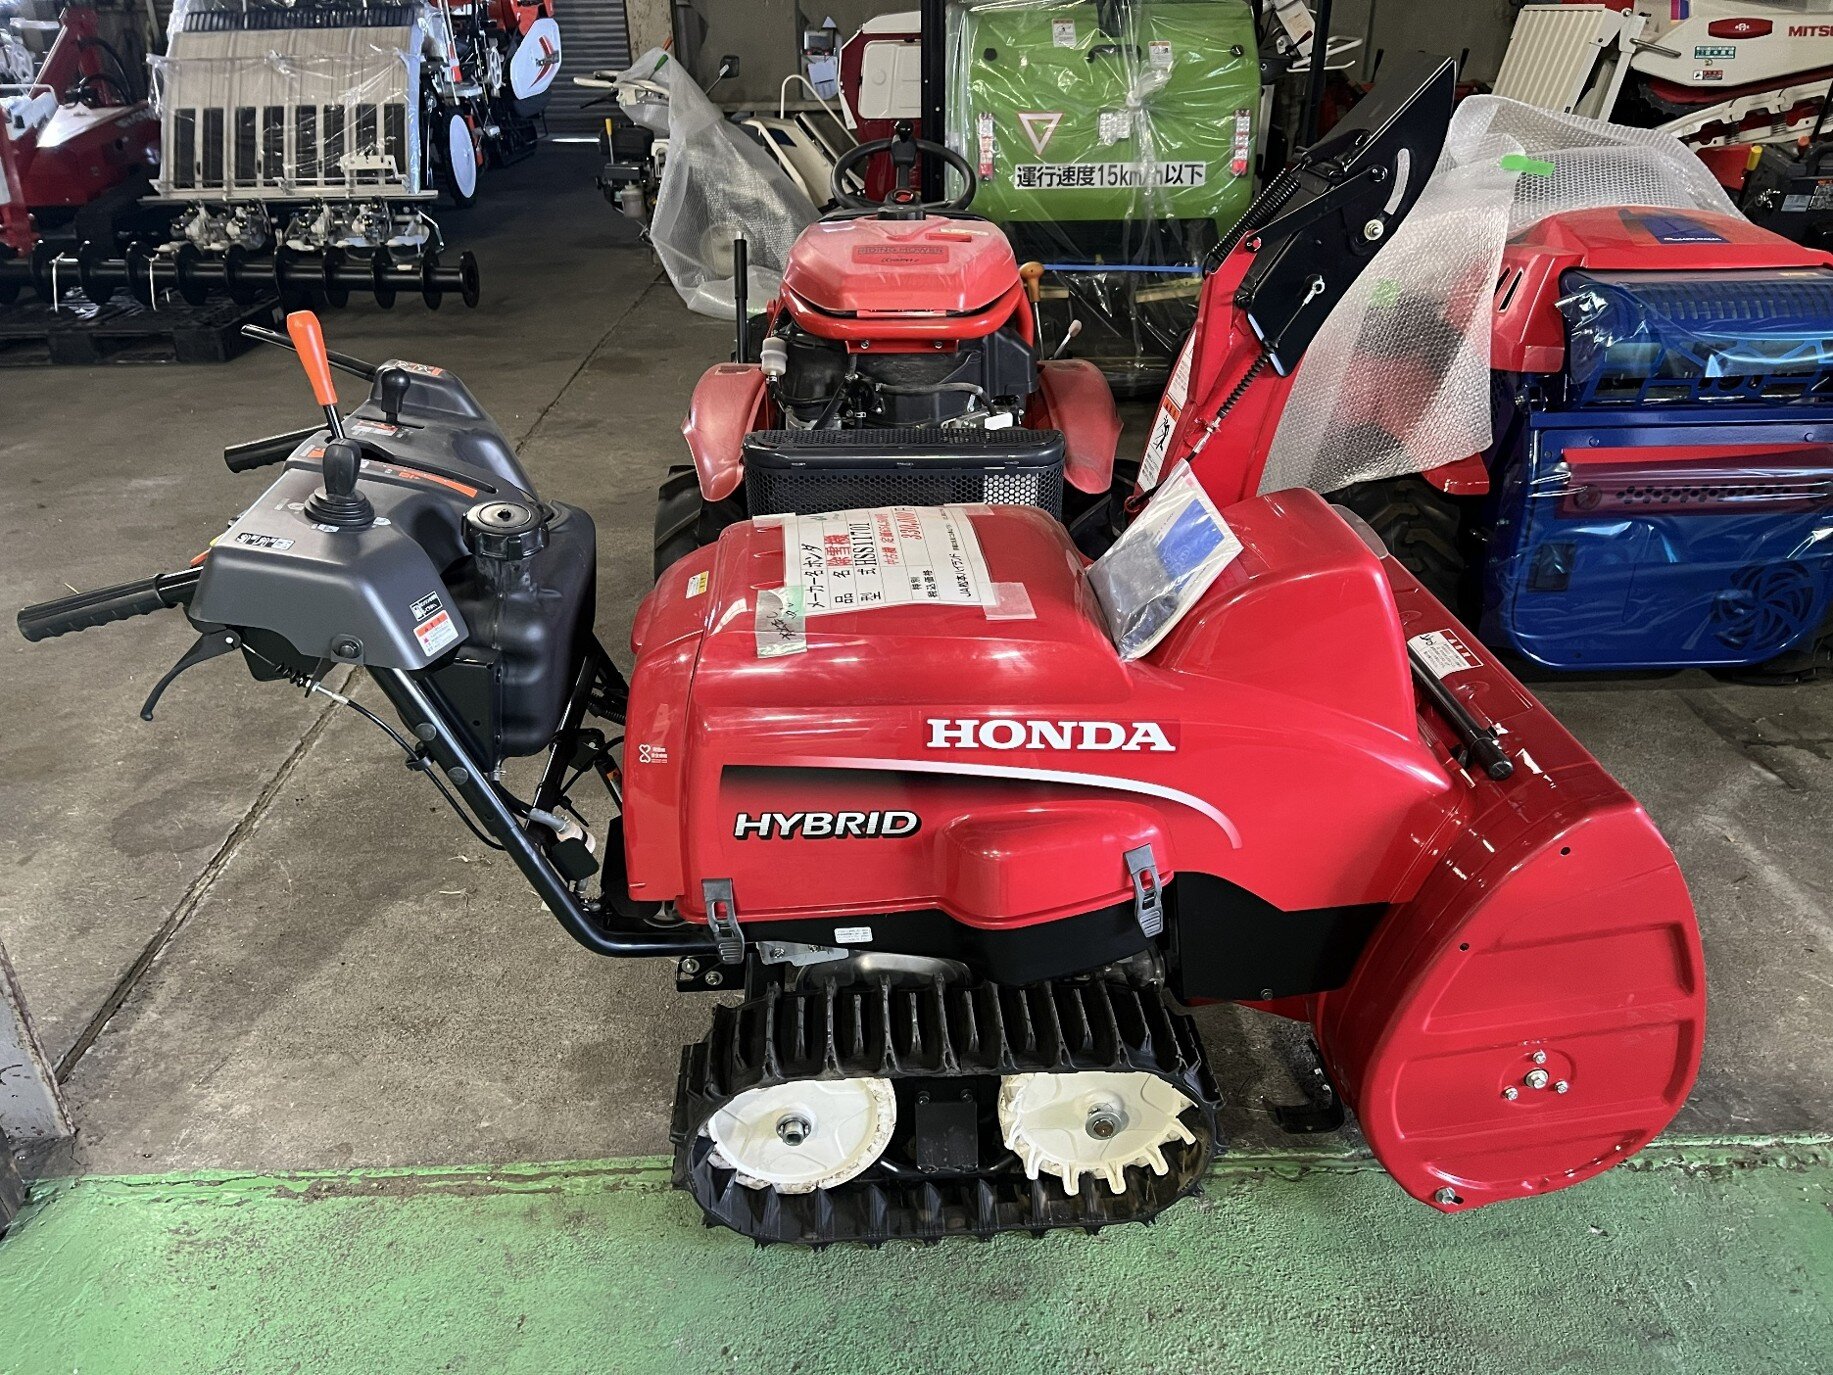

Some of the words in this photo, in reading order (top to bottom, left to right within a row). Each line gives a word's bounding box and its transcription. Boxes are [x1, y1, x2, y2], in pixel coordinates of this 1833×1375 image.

[1788, 25, 1833, 37] MITS
[1017, 164, 1204, 187] 運行速度15km/h以下
[801, 543, 822, 568] ホンダ
[823, 534, 852, 567] 除雪機
[804, 569, 825, 608] メーカー名
[834, 592, 853, 604] 品
[926, 718, 1176, 751] HONDA
[734, 811, 922, 839] HYBRID
